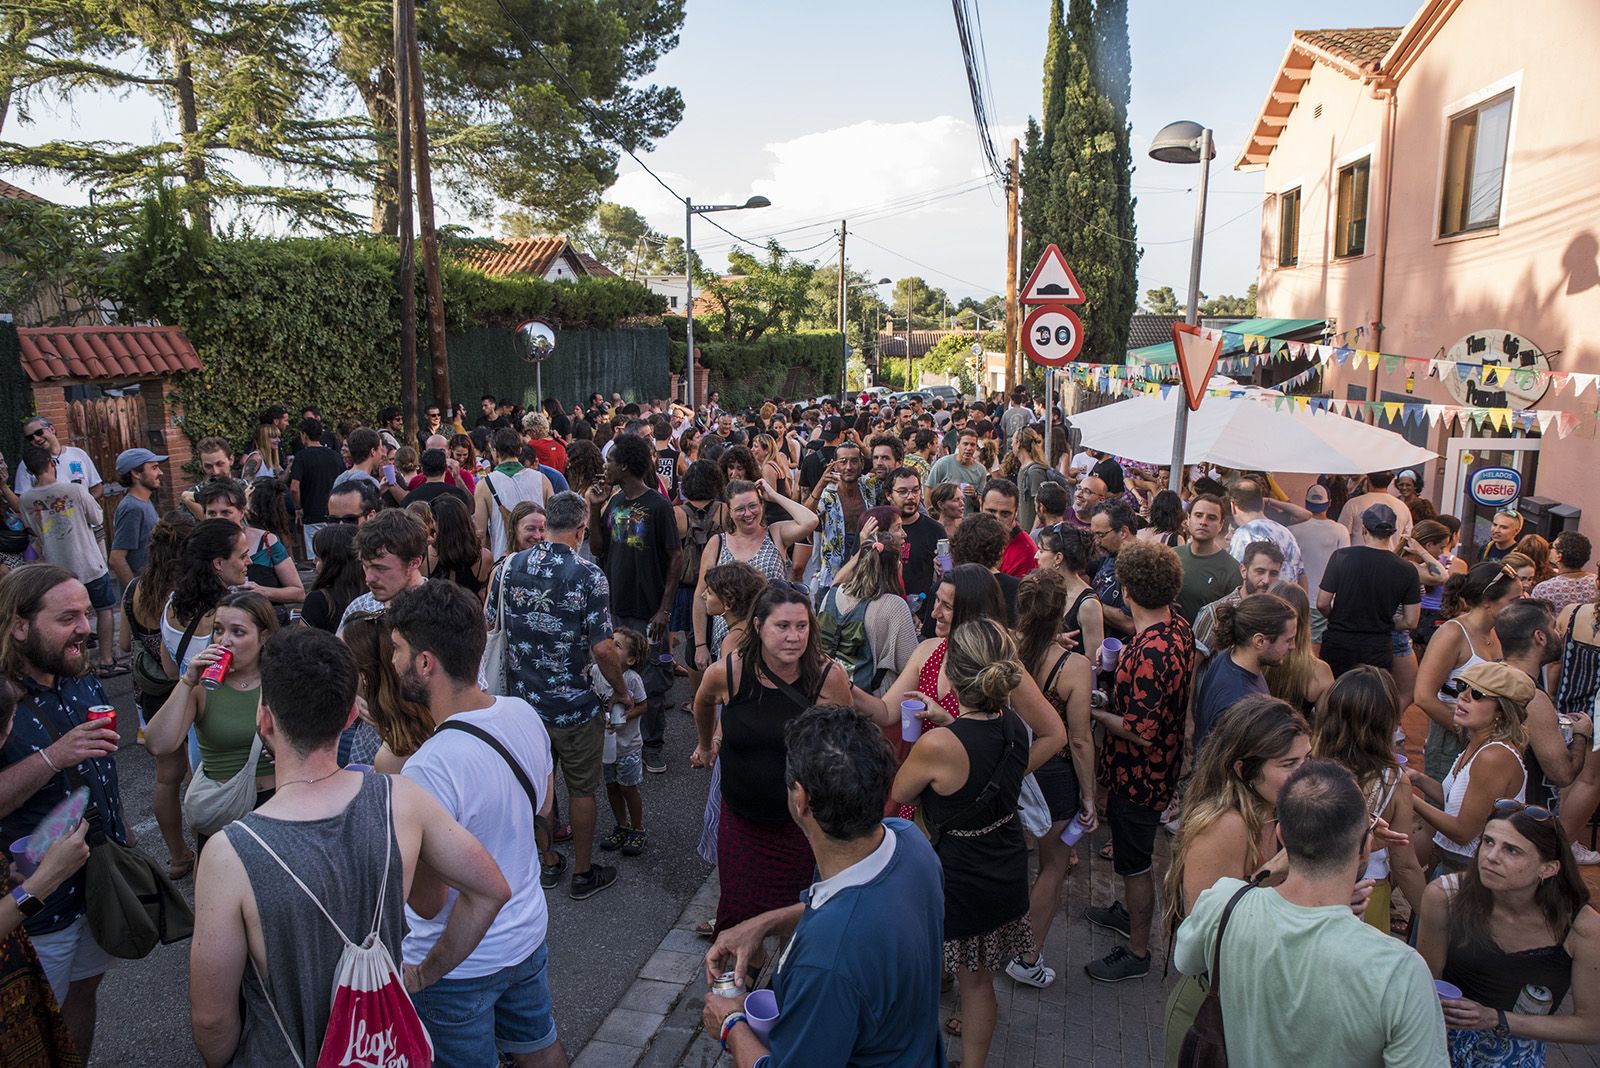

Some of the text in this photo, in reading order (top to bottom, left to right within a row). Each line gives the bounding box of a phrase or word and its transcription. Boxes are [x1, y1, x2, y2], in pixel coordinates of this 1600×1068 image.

[1035, 325, 1071, 346] 30
[1482, 471, 1512, 479] HELADOS
[1476, 483, 1515, 496] Nestlé
